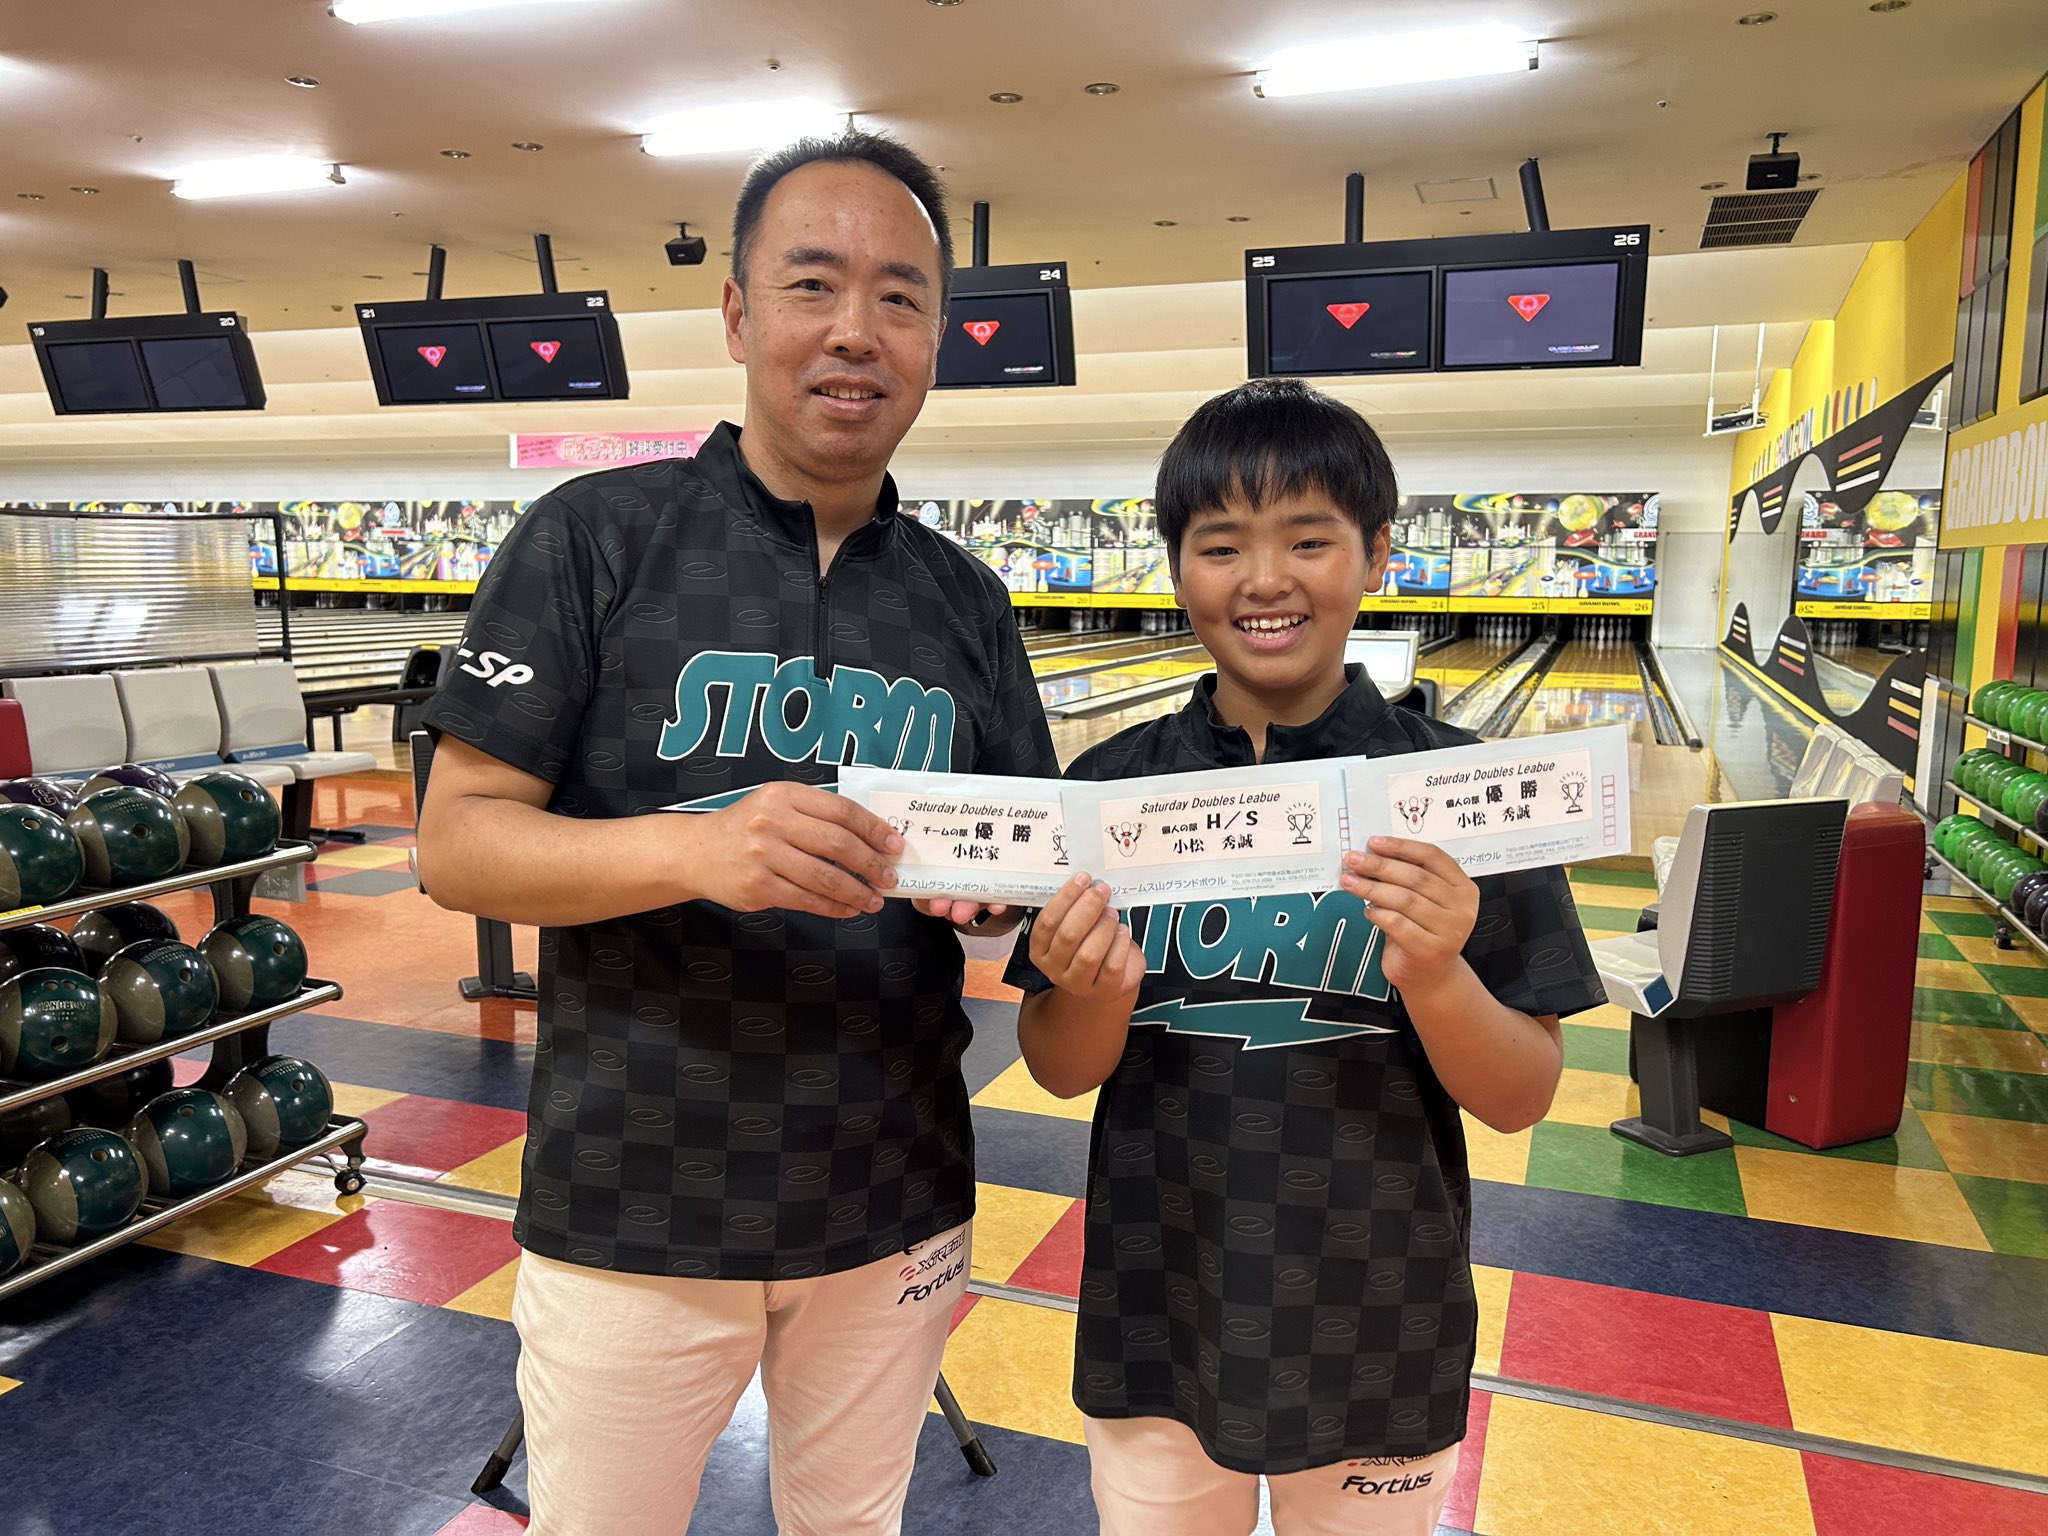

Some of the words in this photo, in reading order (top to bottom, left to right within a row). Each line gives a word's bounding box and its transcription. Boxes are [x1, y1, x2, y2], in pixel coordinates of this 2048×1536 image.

[1613, 233, 1641, 247] 26
[1251, 255, 1276, 268] 25
[1039, 269, 1062, 281] 24
[586, 296, 605, 308] 22
[219, 317, 236, 327] 20
[361, 308, 376, 319] 21
[657, 650, 956, 774] STORM
[1425, 772, 1471, 788] Saturday
[1473, 766, 1515, 781] Doubles
[908, 799, 958, 815] Saturday
[959, 803, 1005, 817] Doubles
[1140, 799, 1189, 814] Saturday
[1191, 795, 1236, 809] Doubles
[1456, 811, 1487, 829] 小松
[952, 843, 1000, 861] 小松家
[1173, 838, 1205, 854] 小松
[896, 878, 990, 893] ムス山グランドボウル
[1112, 876, 1227, 896] ジェームス山グランドボウル
[1121, 889, 1392, 1002] TORM
[897, 1256, 965, 1305] Fortius
[1341, 1471, 1434, 1495] Fortius
